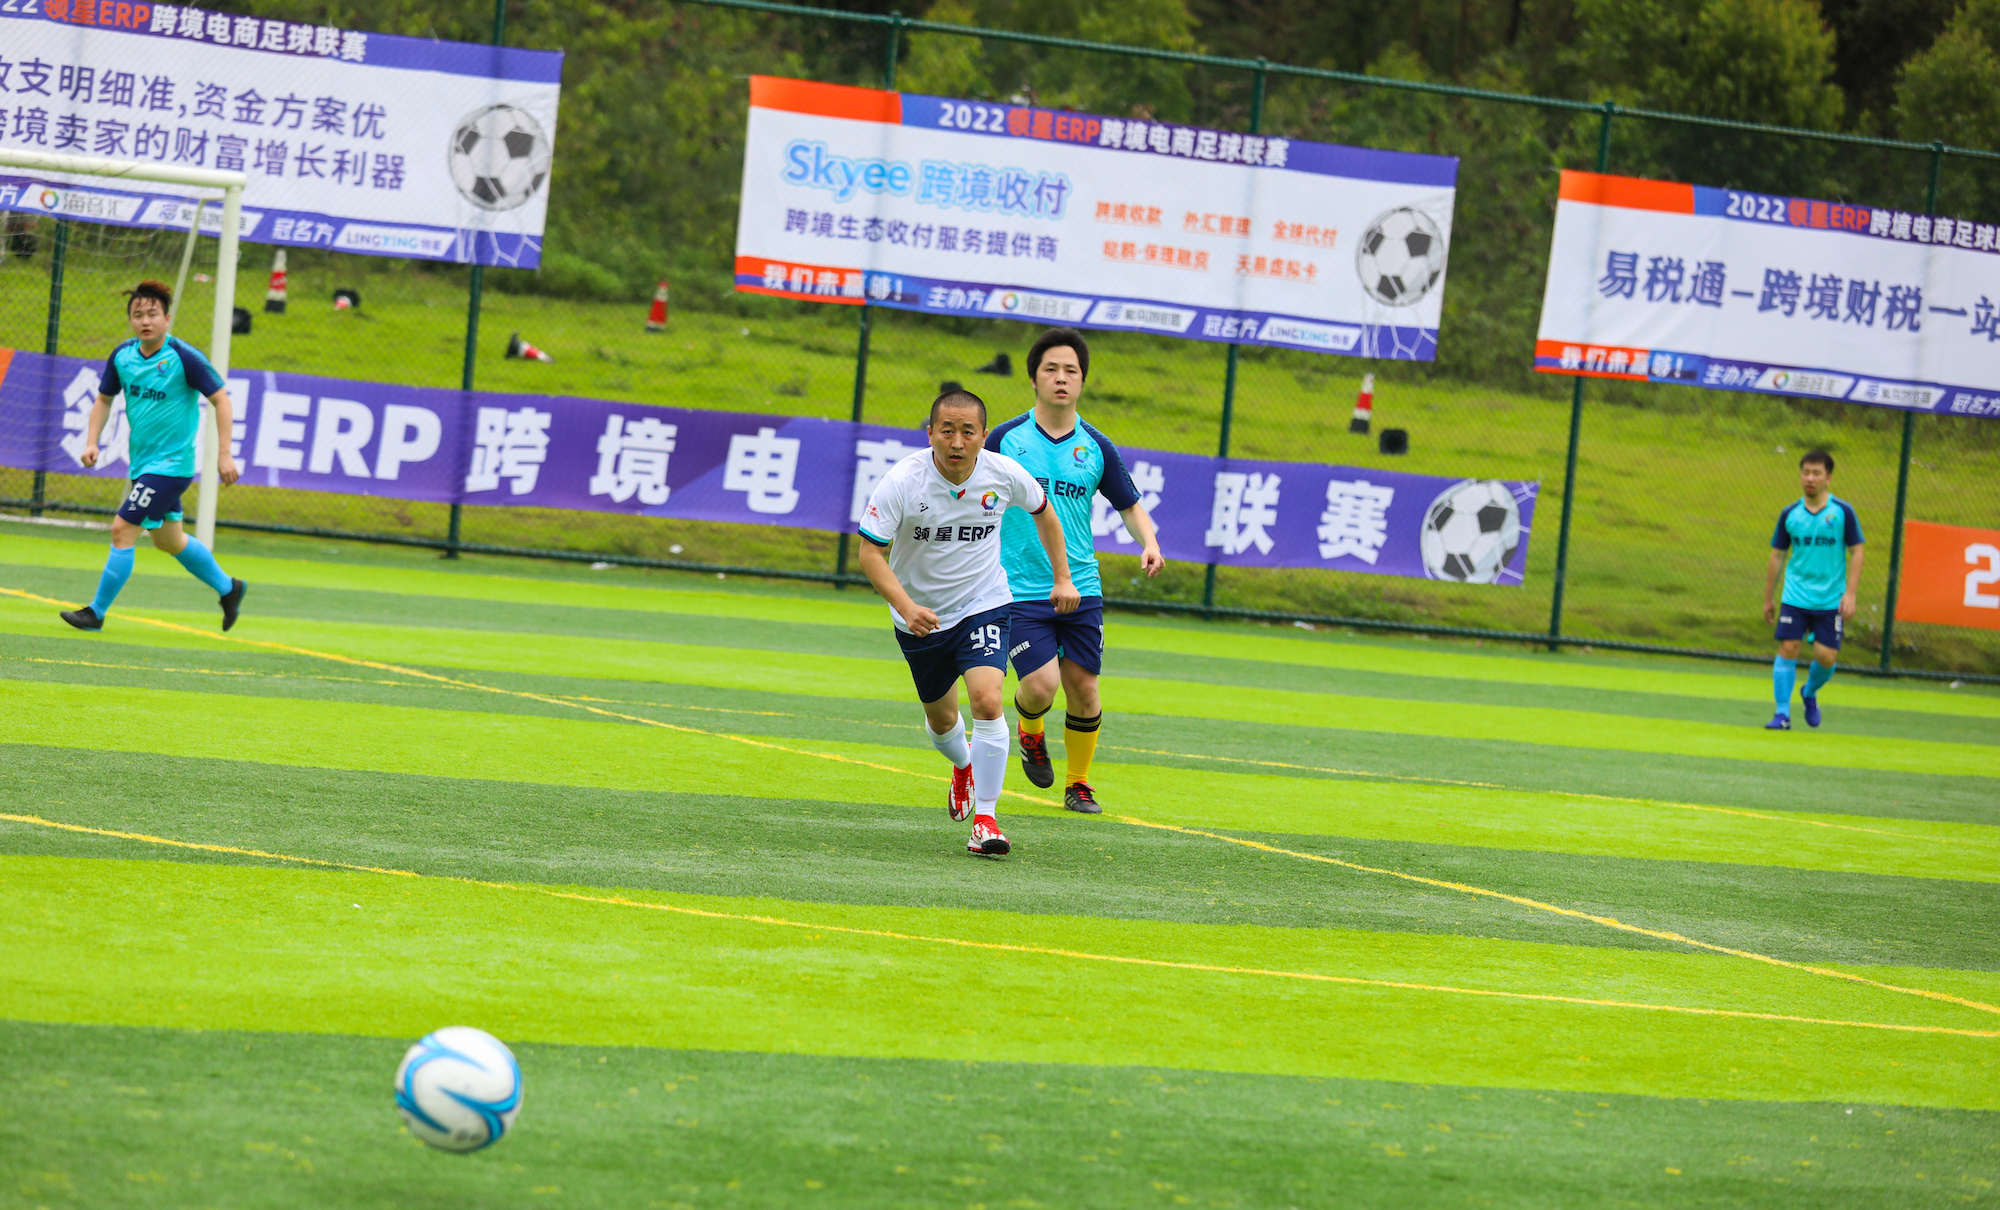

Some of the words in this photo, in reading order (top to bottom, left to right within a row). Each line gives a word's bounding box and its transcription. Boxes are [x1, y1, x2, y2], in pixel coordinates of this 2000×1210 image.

[0, 104, 406, 190] 境卖家的财富增长利器
[784, 142, 912, 200] Skyee
[919, 162, 1069, 217] 跨境收付
[273, 217, 336, 246] 冠名方
[346, 231, 418, 250] LINGXING
[785, 208, 1059, 262] 跨境生态收付服务提供商
[1726, 192, 2000, 253] 2022领星ERP跨境电商足球
[129, 482, 156, 508] 66
[1963, 542, 2000, 609] 2
